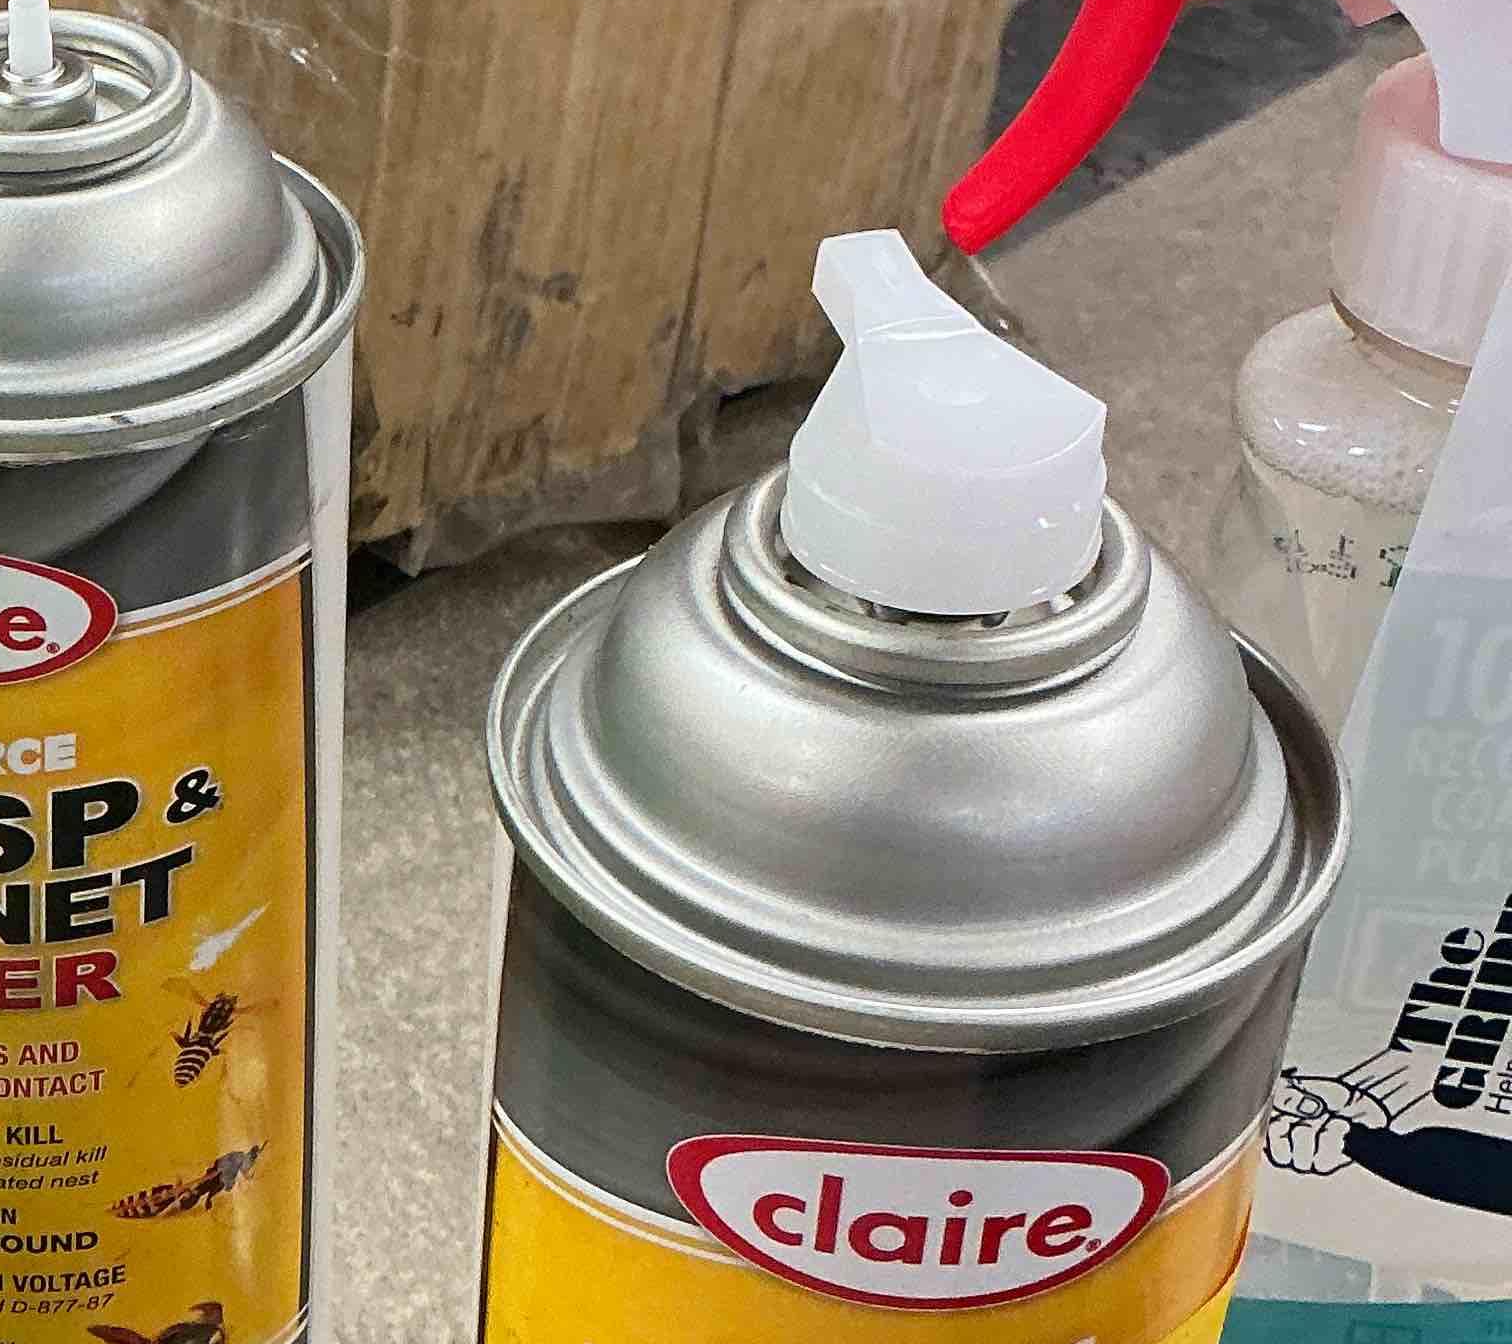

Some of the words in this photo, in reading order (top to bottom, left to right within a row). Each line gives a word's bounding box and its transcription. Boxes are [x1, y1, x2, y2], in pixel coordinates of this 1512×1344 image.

[163, 766, 223, 826] &
[1389, 926, 1486, 1054] The
[18, 1040, 81, 1067] AND
[6, 1124, 65, 1146] KILL
[75, 1143, 109, 1165] kill
[49, 1168, 100, 1190] nest
[750, 1172, 1095, 1268] claire
[11, 1263, 127, 1294] VOLTAGE
